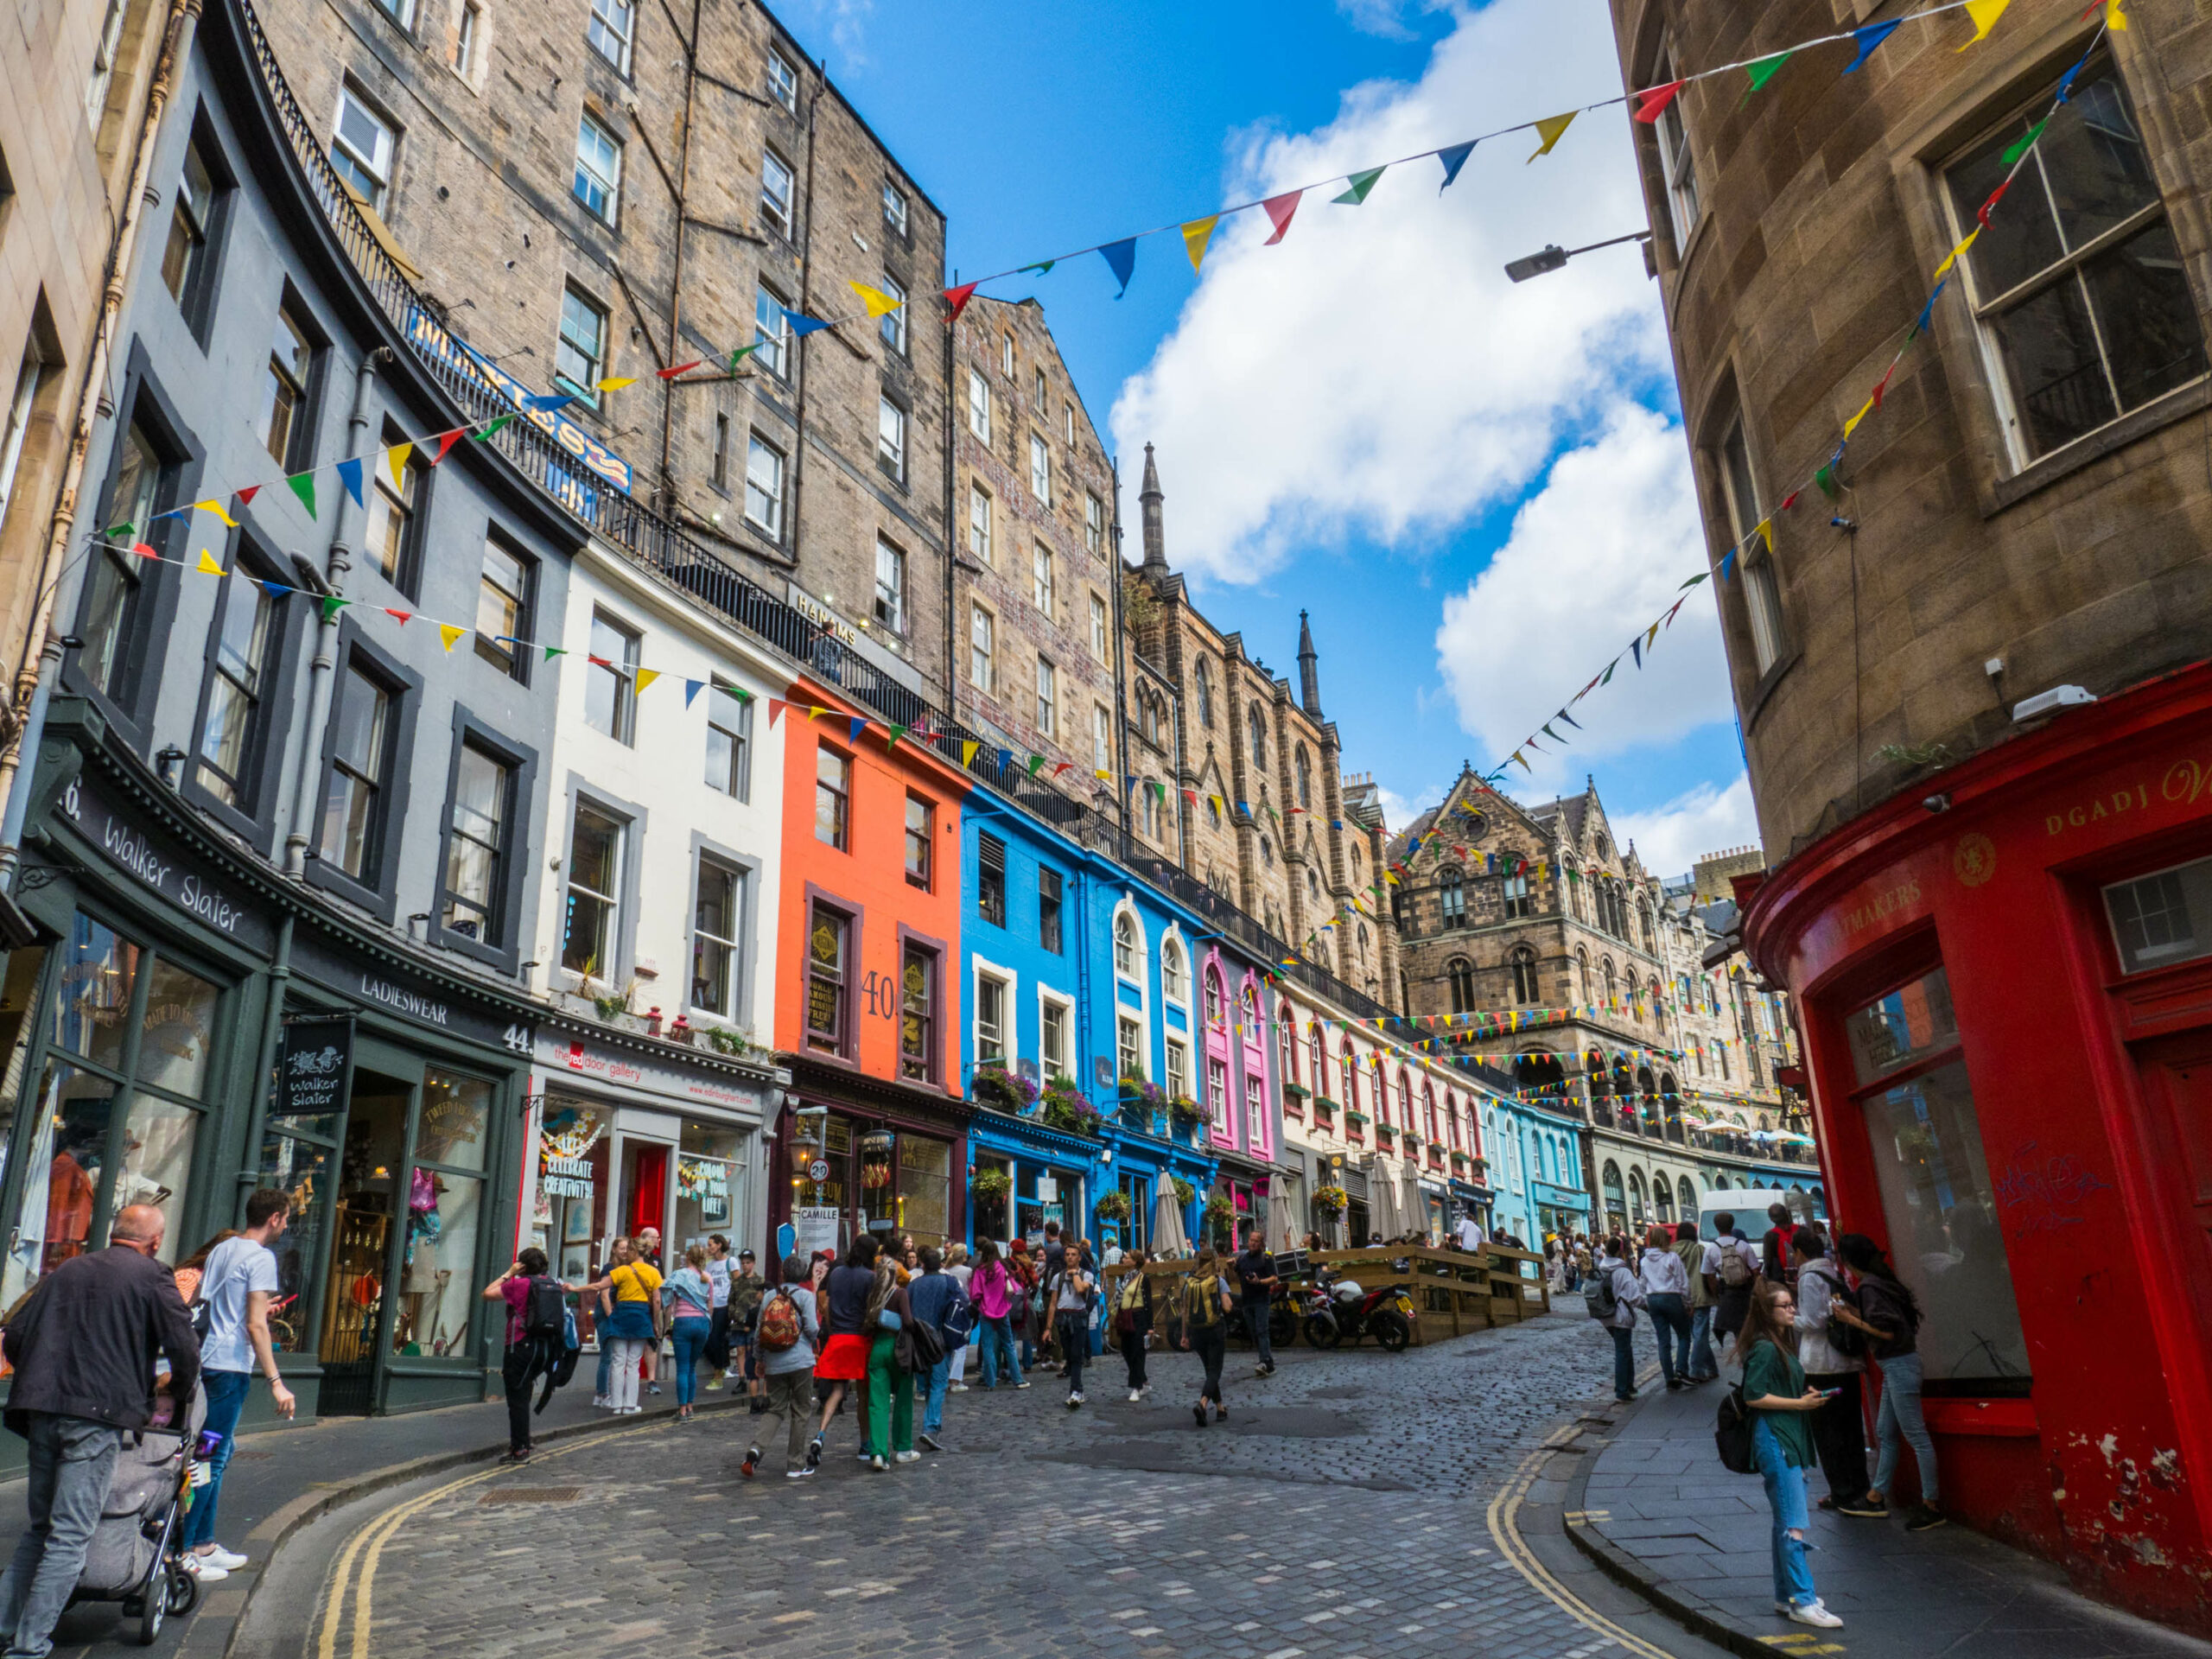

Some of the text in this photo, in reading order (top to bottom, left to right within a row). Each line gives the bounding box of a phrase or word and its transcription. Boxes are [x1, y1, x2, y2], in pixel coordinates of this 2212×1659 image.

[105, 815, 243, 932] Walker Slater
[361, 975, 448, 1025] LADIESWEAR
[861, 970, 894, 1020] 40
[554, 1046, 641, 1083] the red door gallery
[689, 1085, 753, 1105] www.edinburghart.com
[547, 1154, 594, 1179] CELEBRATE
[544, 1174, 594, 1199] CREATIVITY!
[800, 1180, 842, 1204] MUEUM
[702, 1197, 721, 1214] LIFE!
[801, 1210, 837, 1219] CAMILLE
